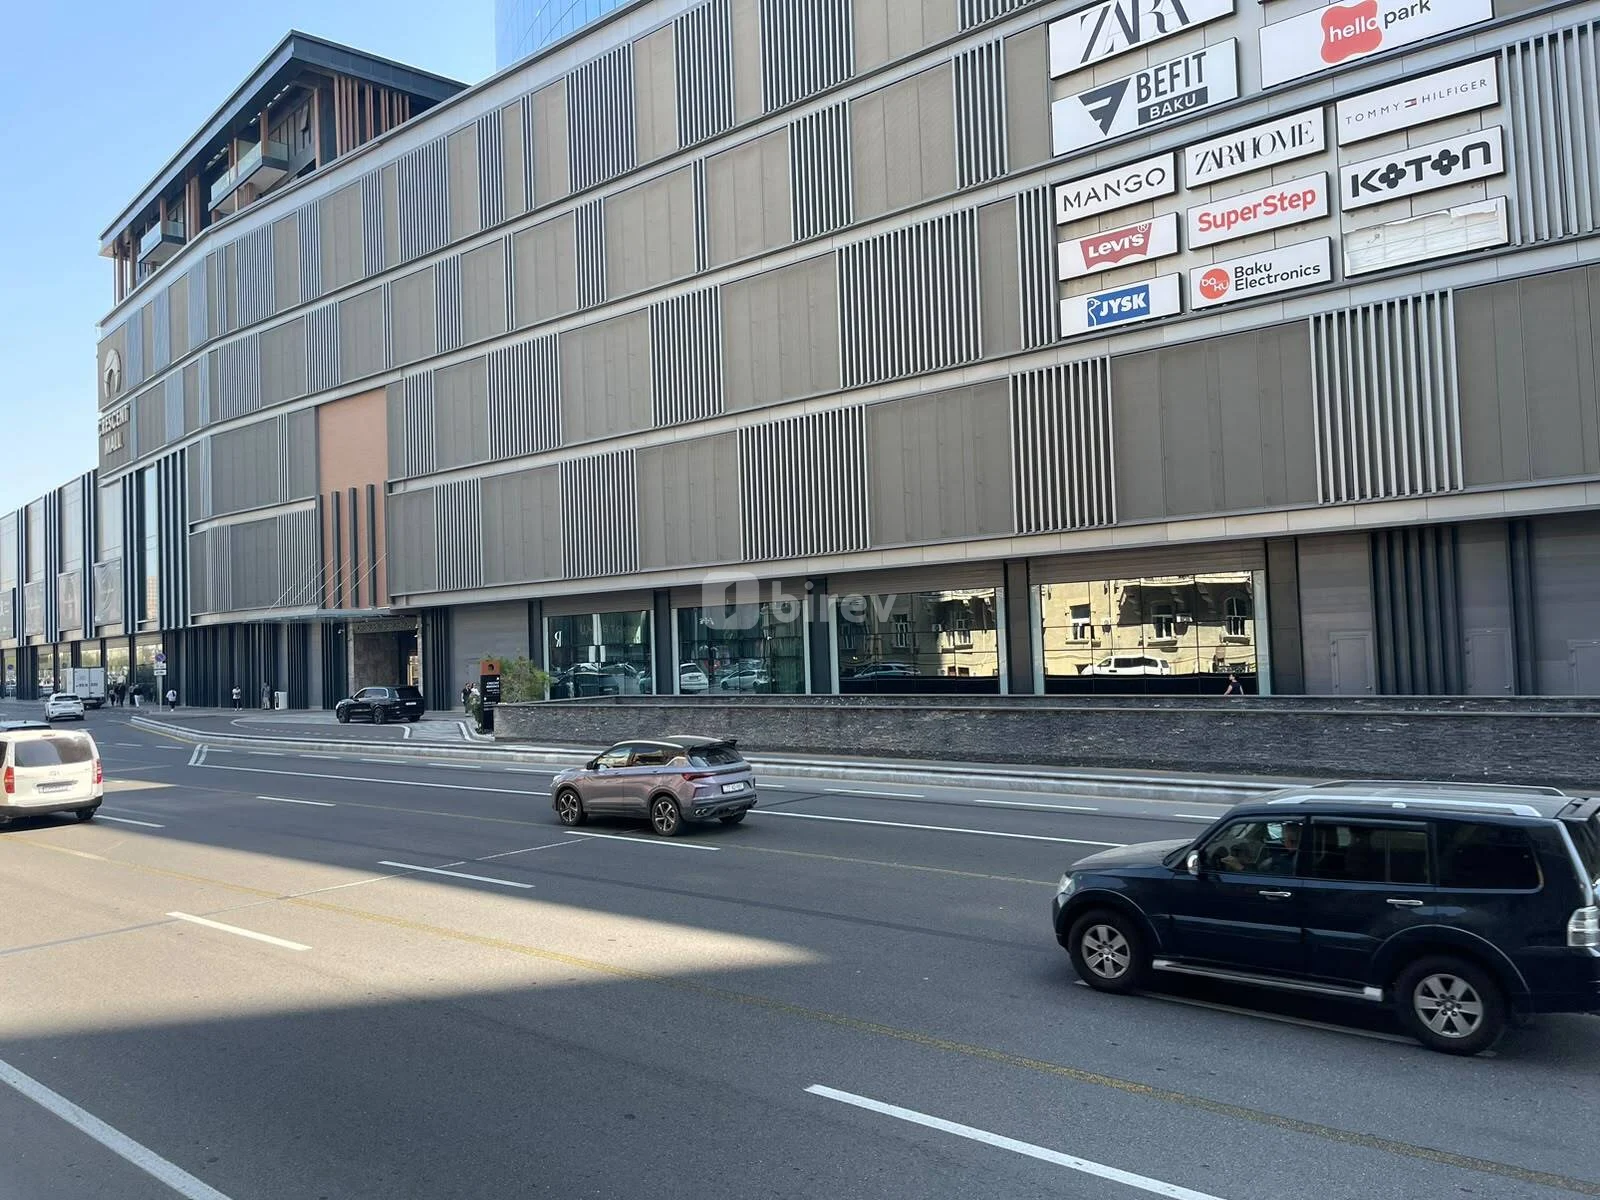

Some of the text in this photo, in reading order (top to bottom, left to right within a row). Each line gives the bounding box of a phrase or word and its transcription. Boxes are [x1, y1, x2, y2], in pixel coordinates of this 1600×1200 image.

[1080, 0, 1190, 64] ZARA
[1329, 0, 1431, 43] hello park
[1136, 51, 1207, 104] BEFIT
[1150, 93, 1196, 119] BAKU
[1345, 78, 1487, 125] TOMMY HILFIGER
[1063, 167, 1166, 212] MANGO
[1198, 189, 1316, 232] SuperStep
[1234, 262, 1273, 278] Baku
[1234, 264, 1320, 291] Electronics
[1100, 292, 1147, 317] JYSK
